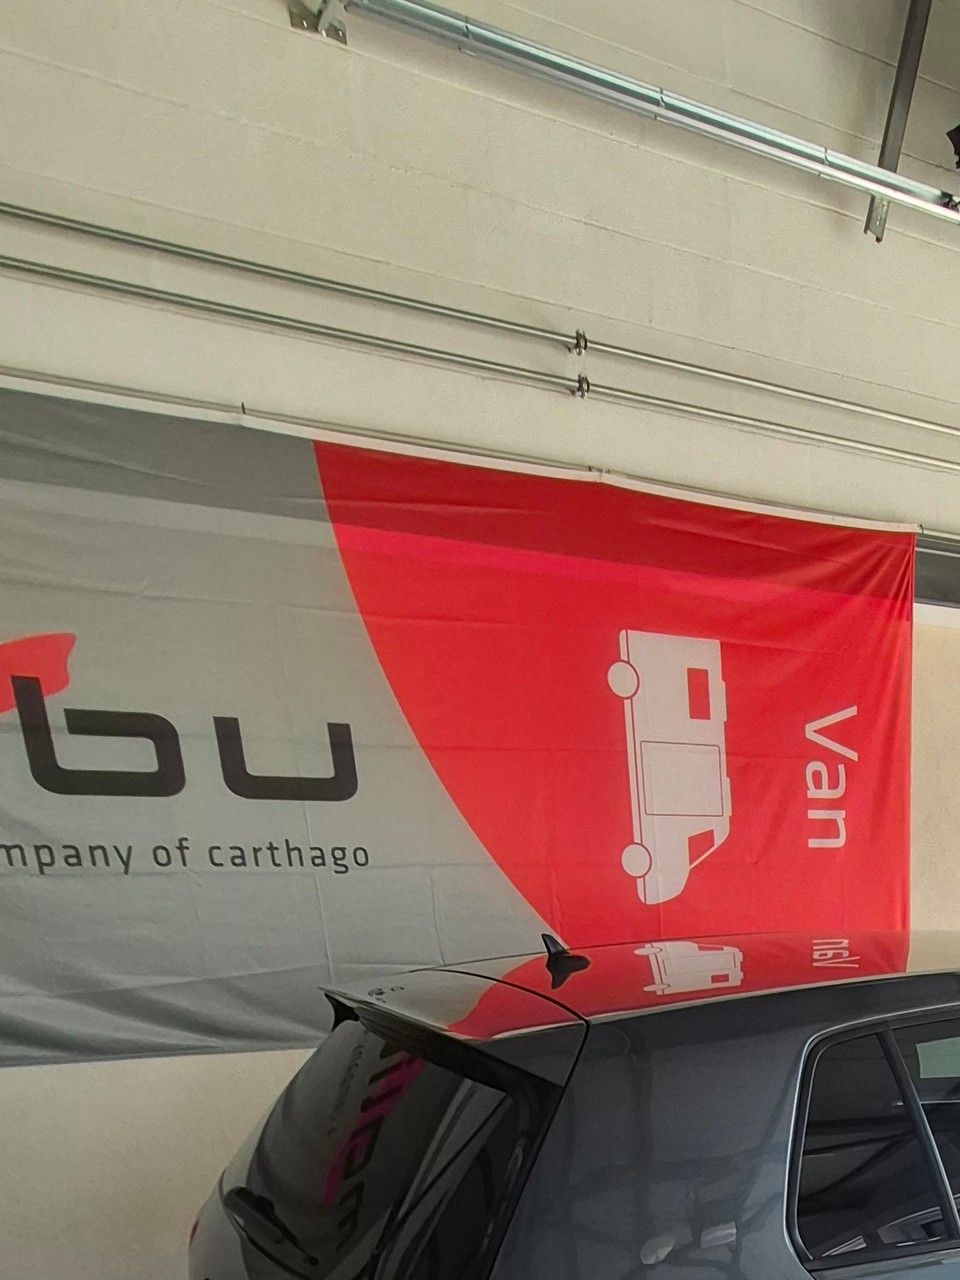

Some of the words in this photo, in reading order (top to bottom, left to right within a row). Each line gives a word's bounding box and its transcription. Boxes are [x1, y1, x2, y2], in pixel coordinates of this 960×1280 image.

[805, 704, 859, 848] Van
[152, 837, 189, 868] of
[207, 838, 370, 874] carthago
